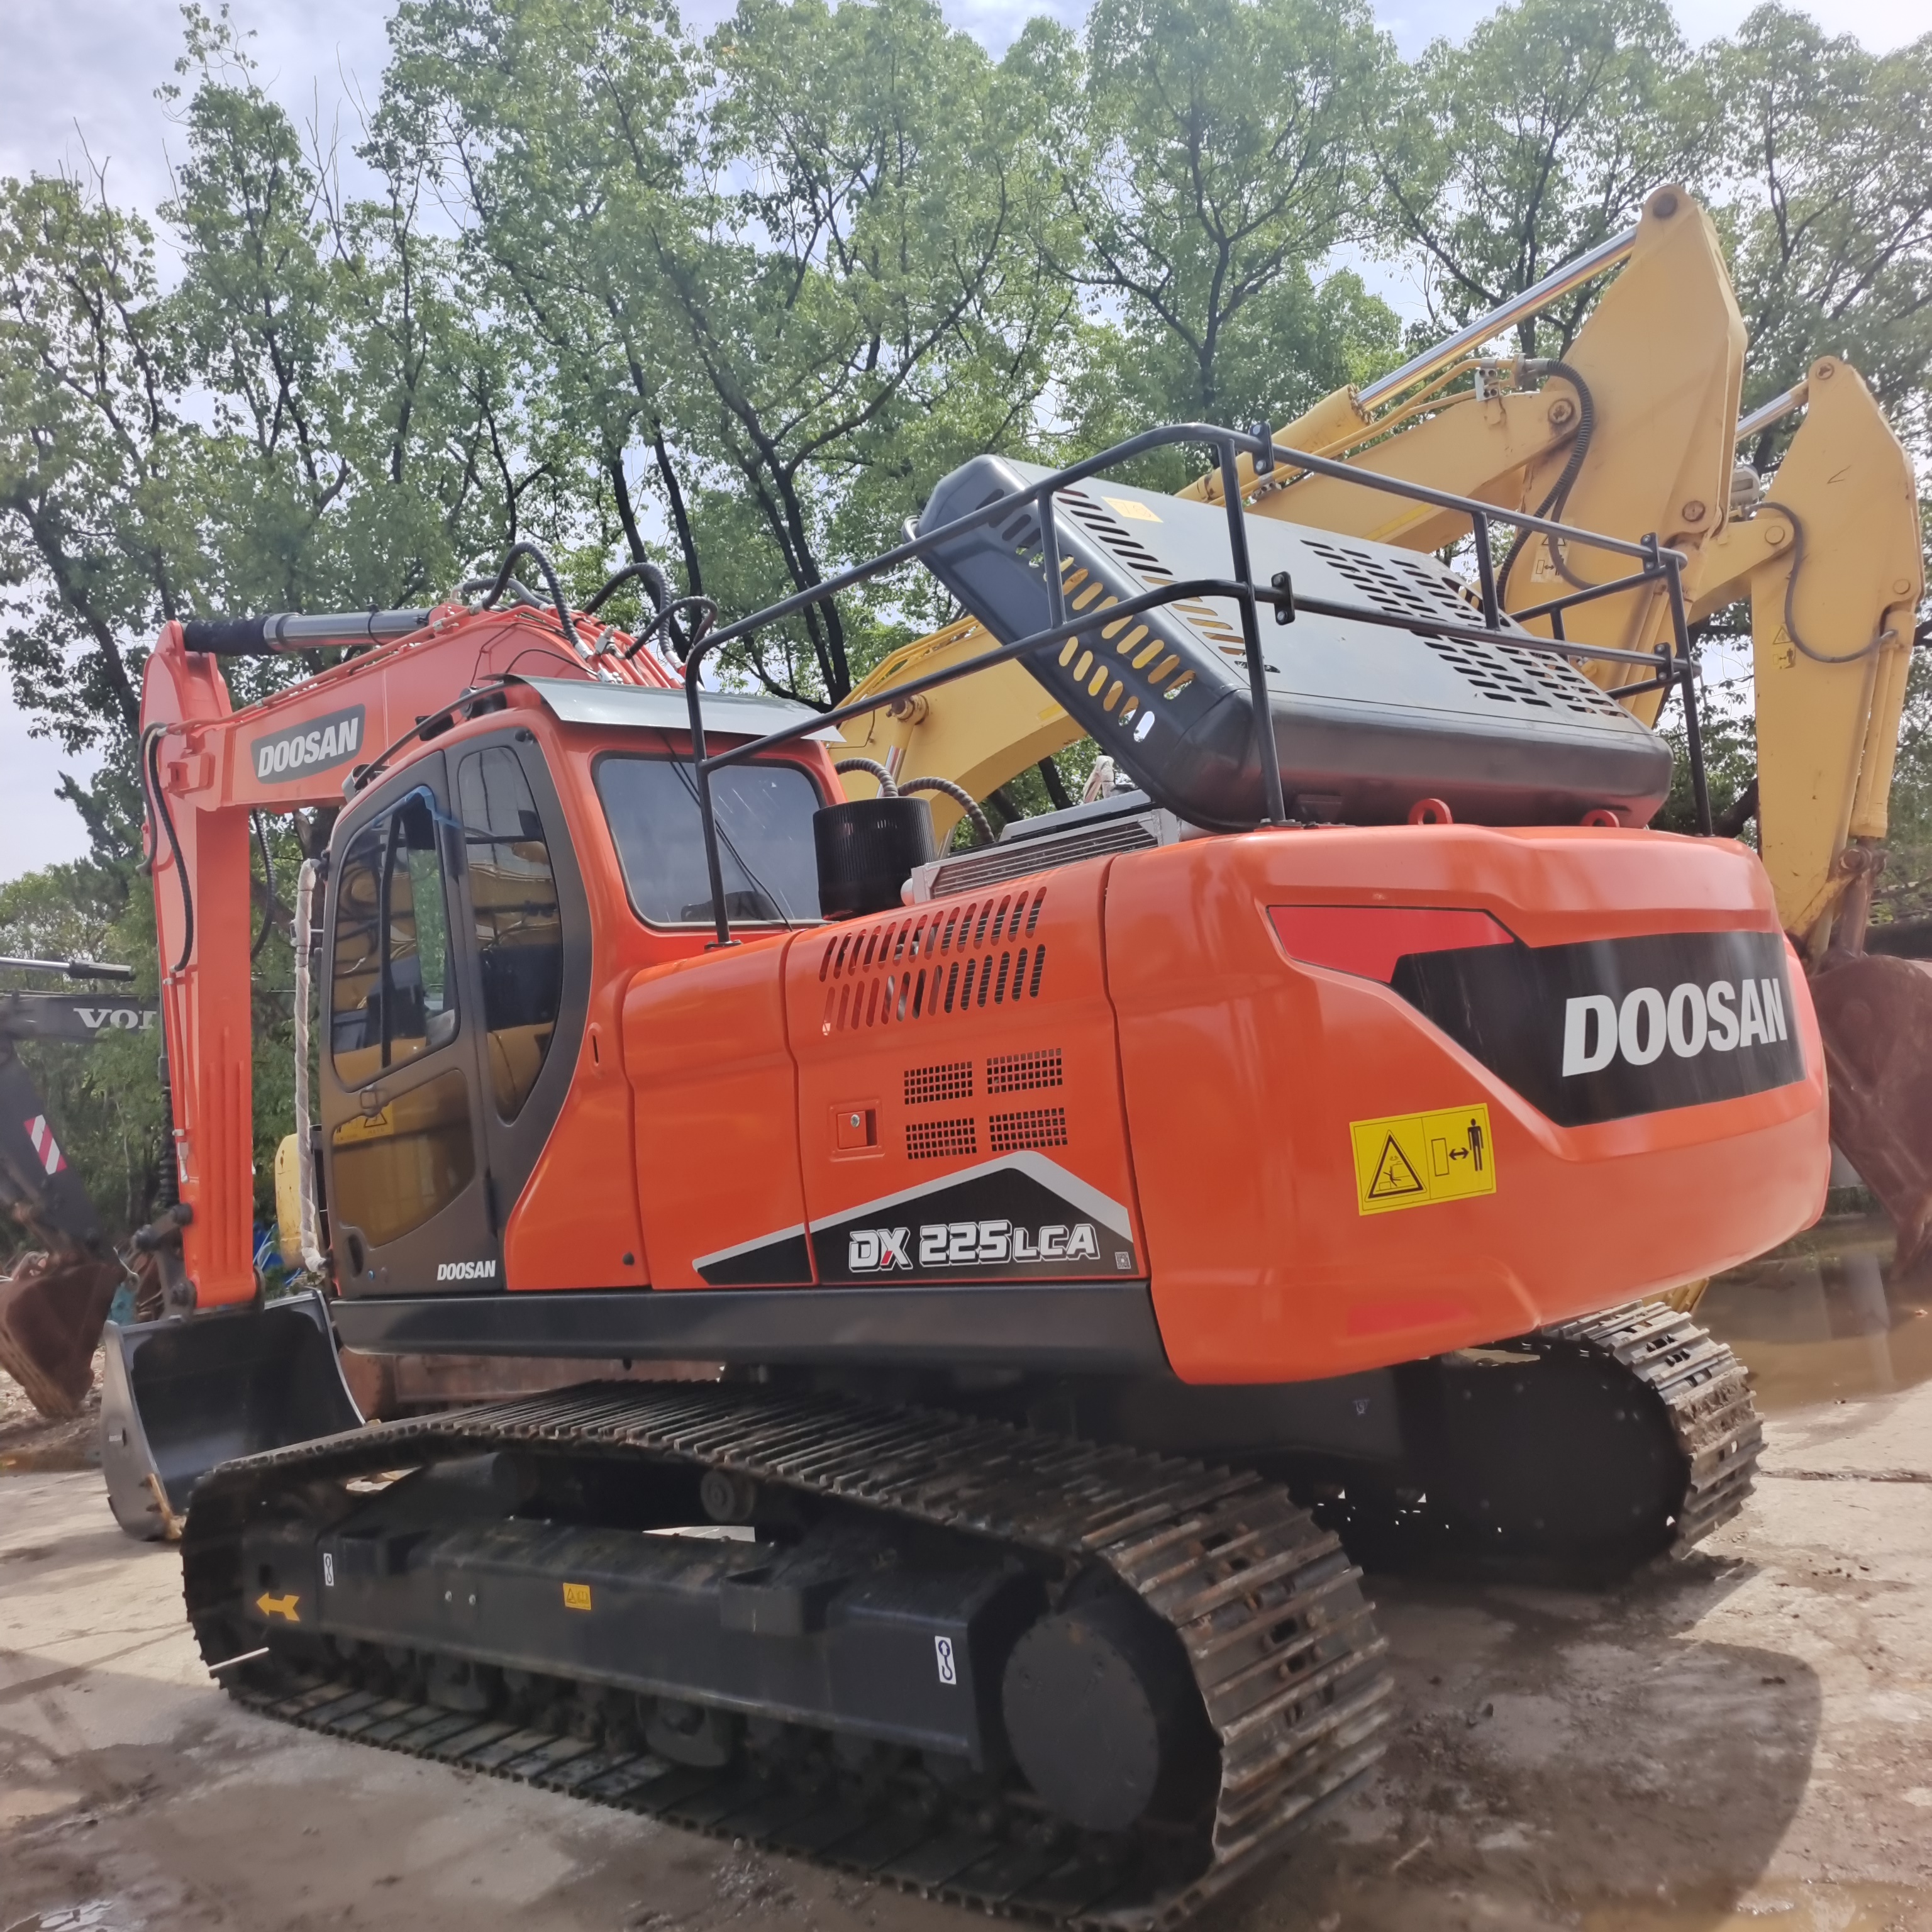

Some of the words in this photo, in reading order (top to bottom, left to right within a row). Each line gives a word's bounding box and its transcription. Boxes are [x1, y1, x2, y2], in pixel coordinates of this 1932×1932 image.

[258, 717, 358, 778] DOOSAN
[1562, 978, 1787, 1077] DOOSAN
[436, 1260, 496, 1280] DOOSAN
[849, 1228, 913, 1272] DX
